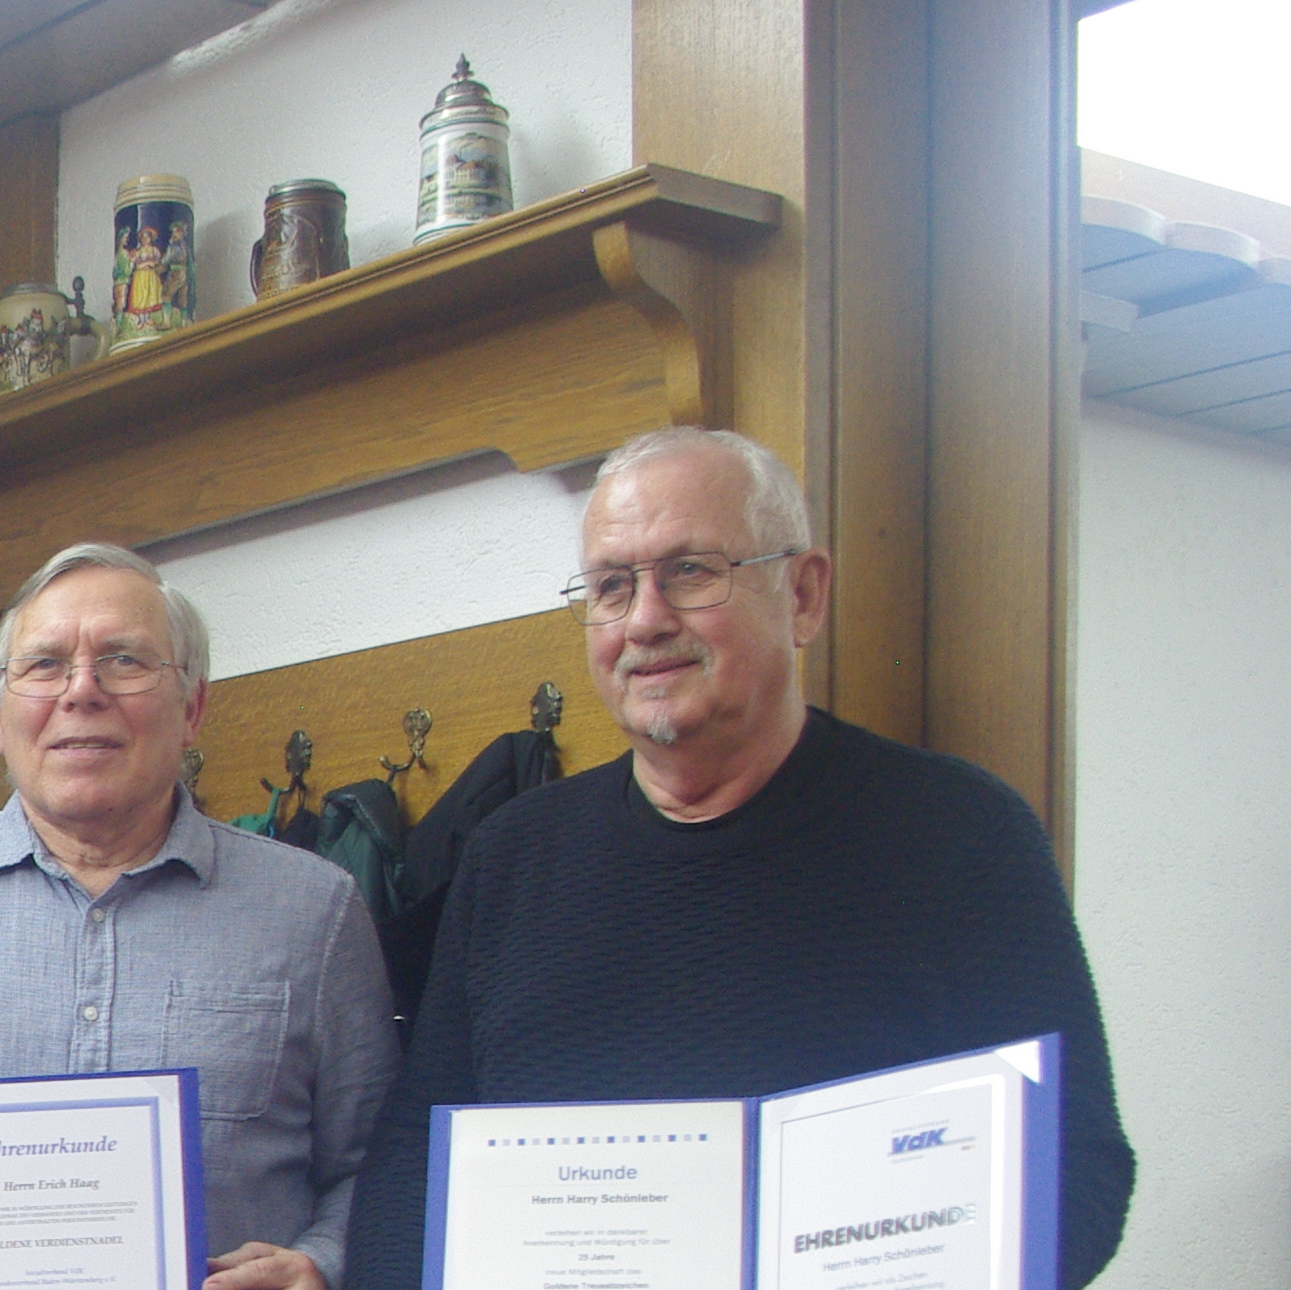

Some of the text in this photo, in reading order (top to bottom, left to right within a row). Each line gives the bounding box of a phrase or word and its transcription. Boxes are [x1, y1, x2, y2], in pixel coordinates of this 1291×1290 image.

[892, 1127, 948, 1155] VdK
[558, 1165, 638, 1181] Urkunde
[38, 1179, 67, 1190] Erich
[70, 1178, 100, 1190] Haag
[531, 1195, 564, 1205] Herrn
[567, 1194, 598, 1205] Harry
[822, 1261, 852, 1272] Herrn
[854, 1255, 881, 1267] Harry
